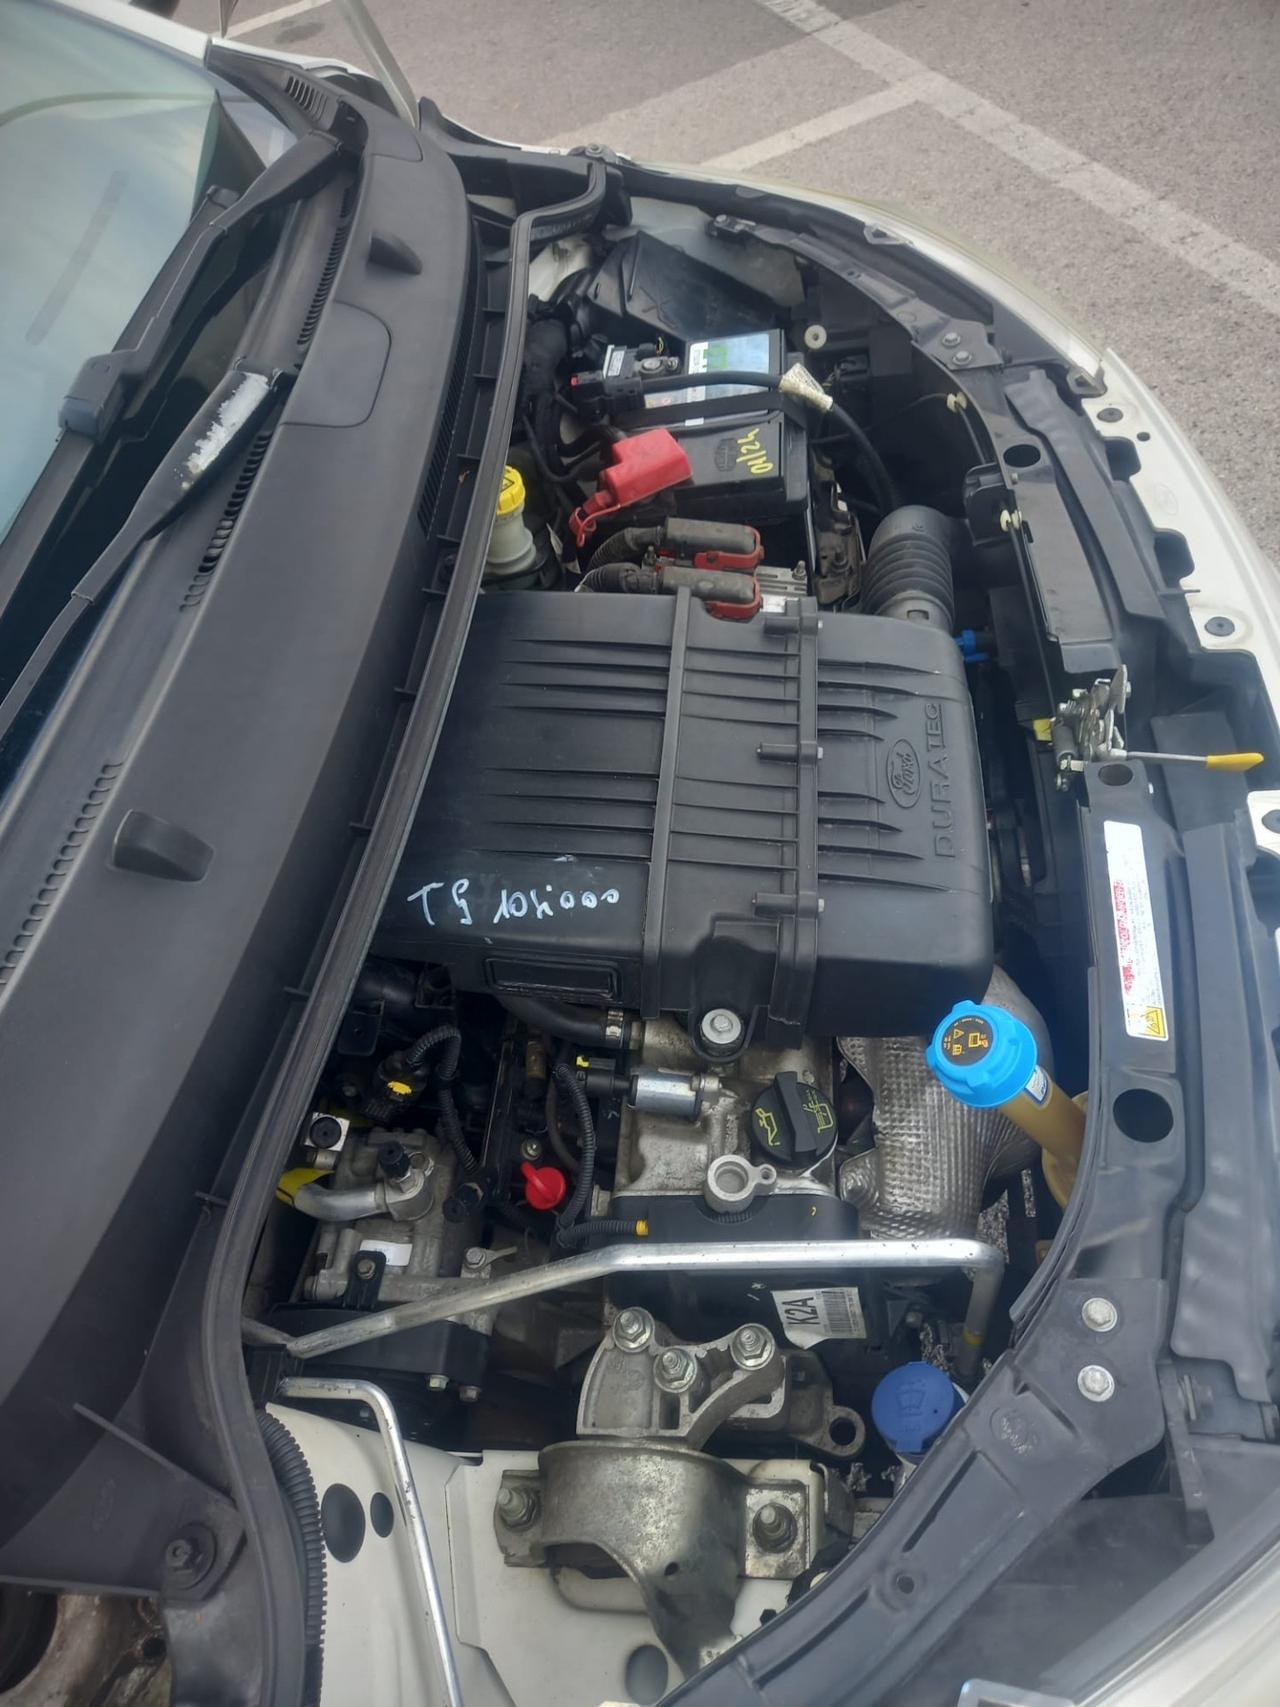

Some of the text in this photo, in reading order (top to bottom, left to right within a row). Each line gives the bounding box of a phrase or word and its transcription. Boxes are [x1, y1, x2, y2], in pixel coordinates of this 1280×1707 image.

[888, 749, 917, 798] Ford
[925, 702, 955, 858] DURATEC
[781, 1296, 821, 1325] K2A
